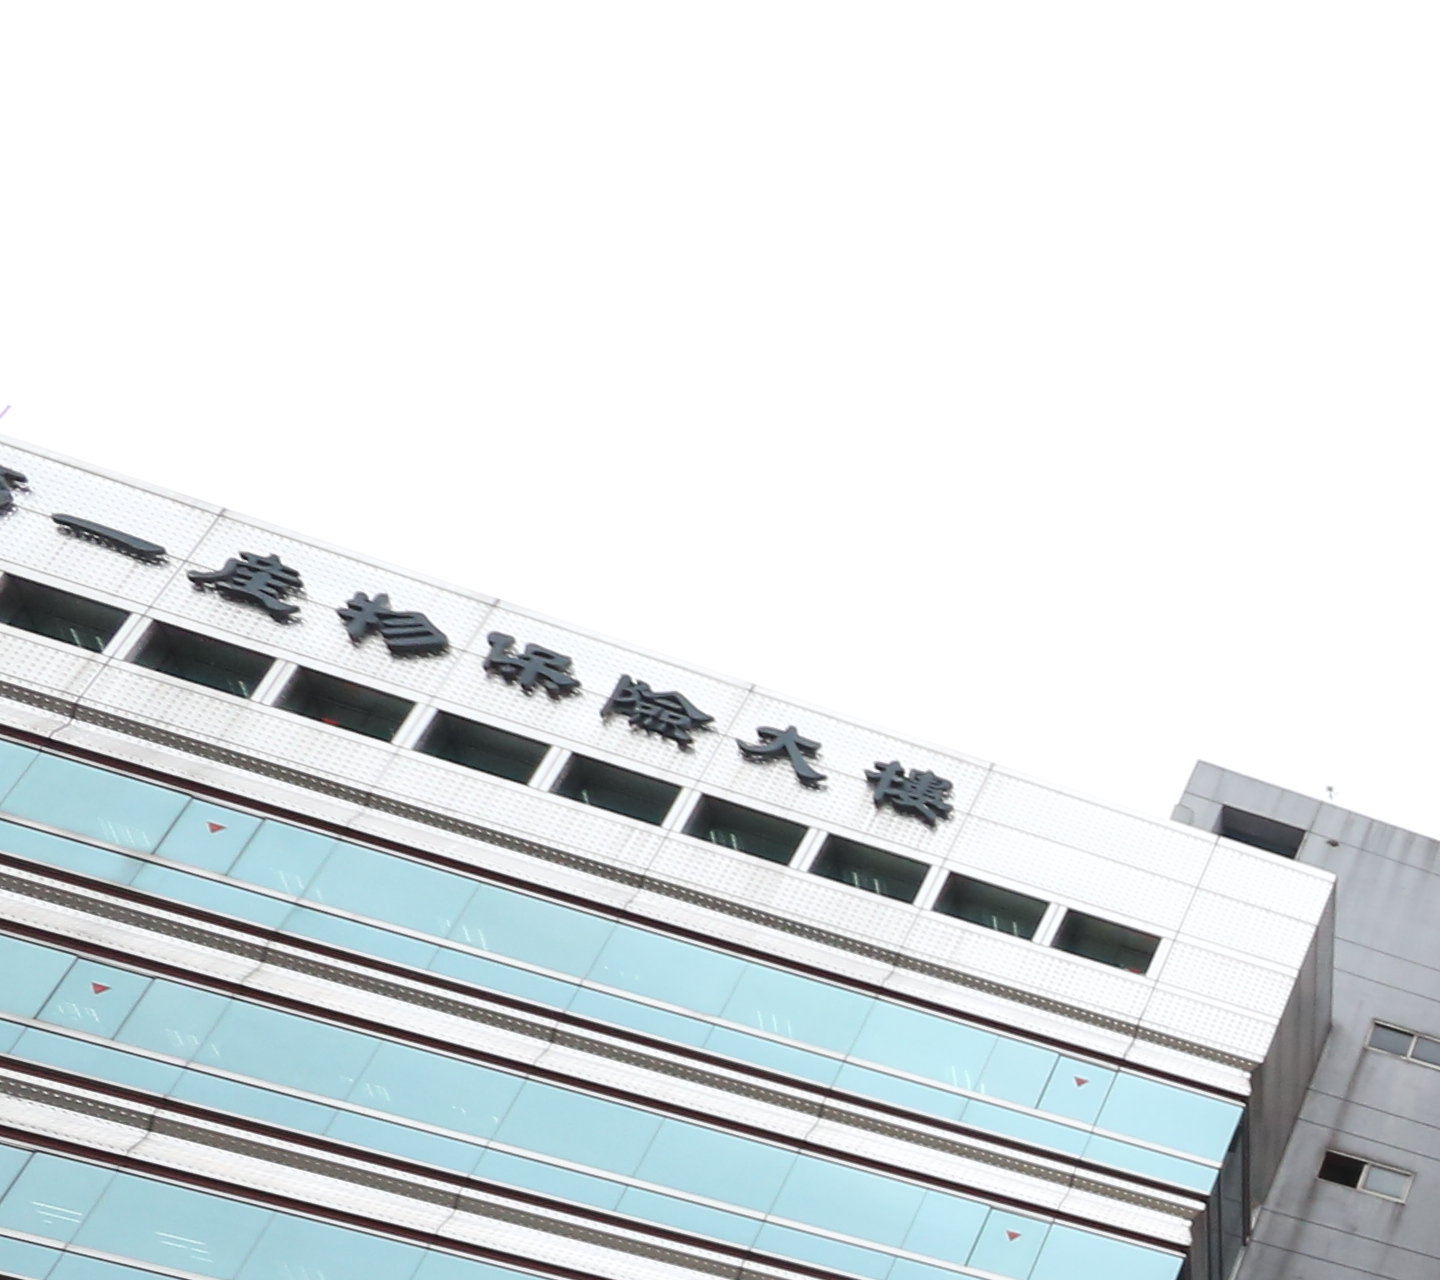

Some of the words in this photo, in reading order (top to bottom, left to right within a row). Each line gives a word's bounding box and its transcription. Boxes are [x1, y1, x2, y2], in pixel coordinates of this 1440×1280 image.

[0, 464, 955, 826] 一產物保險大樓
